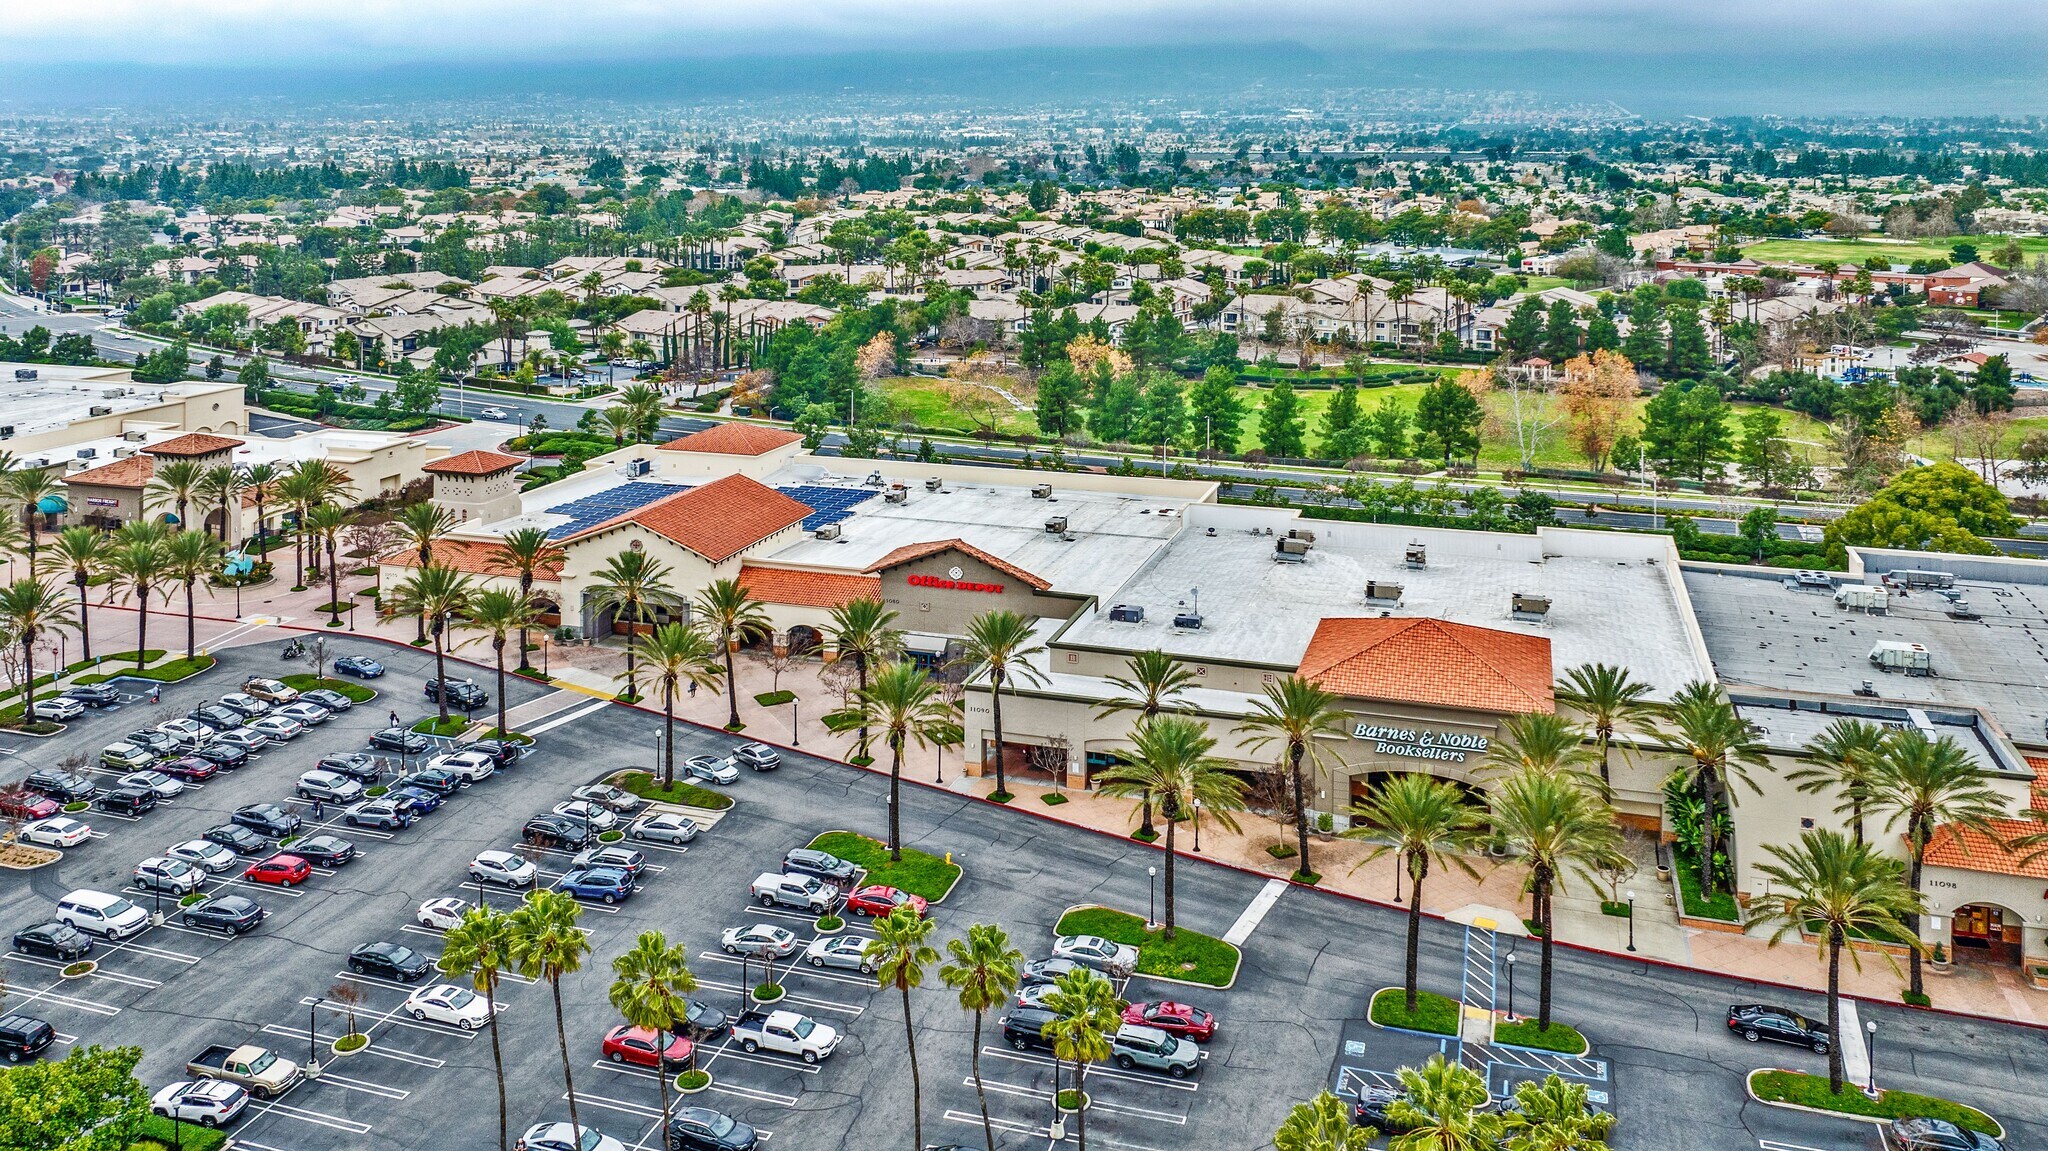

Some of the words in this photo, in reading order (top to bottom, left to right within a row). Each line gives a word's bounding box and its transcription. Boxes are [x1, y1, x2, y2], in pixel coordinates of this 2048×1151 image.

[908, 574, 955, 589] Office
[956, 580, 1004, 594] DEPOT
[970, 706, 990, 714] 11090
[1354, 723, 1416, 742] Barnes
[1419, 729, 1434, 747] &
[1437, 733, 1488, 749] Noble
[1376, 742, 1465, 763] Booksellers
[1929, 880, 1957, 889] 11098
